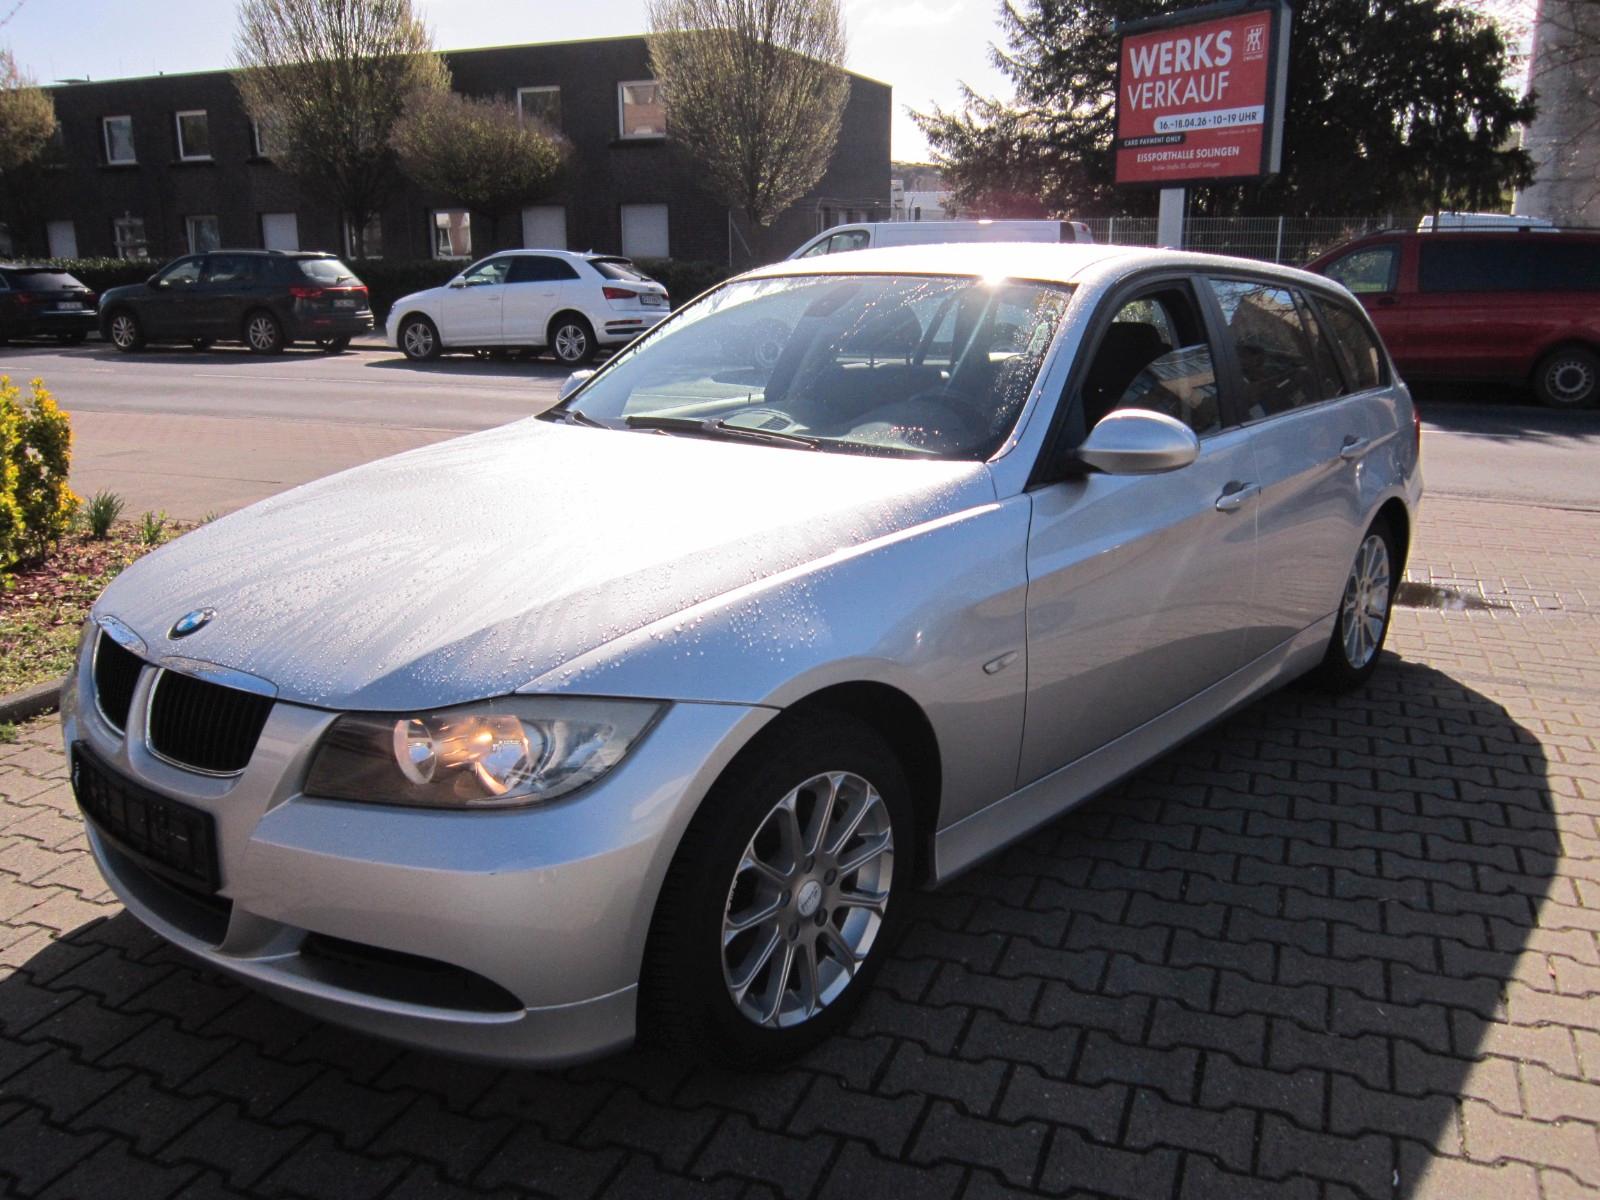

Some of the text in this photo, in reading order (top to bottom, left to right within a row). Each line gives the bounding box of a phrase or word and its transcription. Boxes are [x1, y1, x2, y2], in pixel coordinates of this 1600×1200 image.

[1129, 30, 1233, 79] WERKS
[1127, 71, 1230, 111] VERKAUF
[1213, 113, 1237, 125] 10-19
[1124, 135, 1181, 147] CARD PAYMENT ONLY
[1137, 146, 1240, 163] EISSPORTHALLE SOLINGEN
